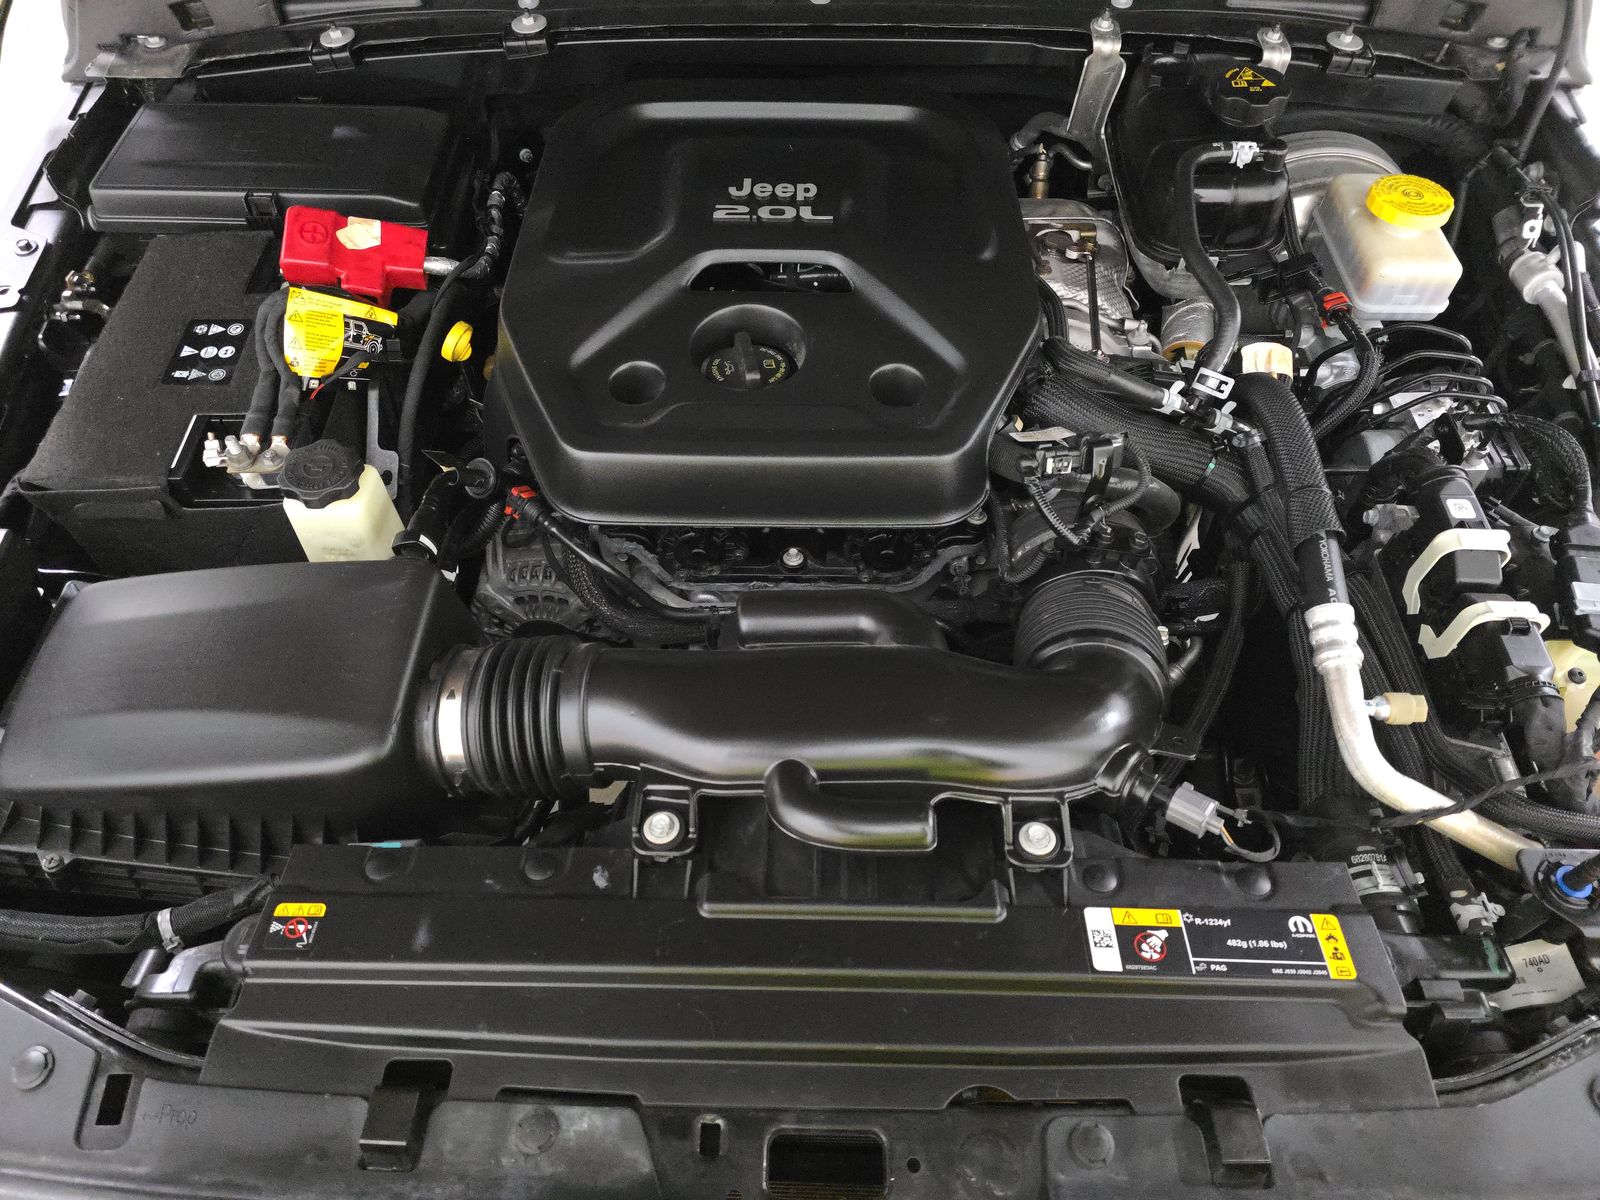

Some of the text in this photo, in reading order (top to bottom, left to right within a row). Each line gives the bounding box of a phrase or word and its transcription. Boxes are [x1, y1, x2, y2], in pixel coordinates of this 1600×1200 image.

[728, 177, 818, 201] Jeep
[712, 204, 834, 223] 2.0L
[1318, 537, 1334, 582] YOKOHAMA
[1210, 964, 1228, 972] PAG
